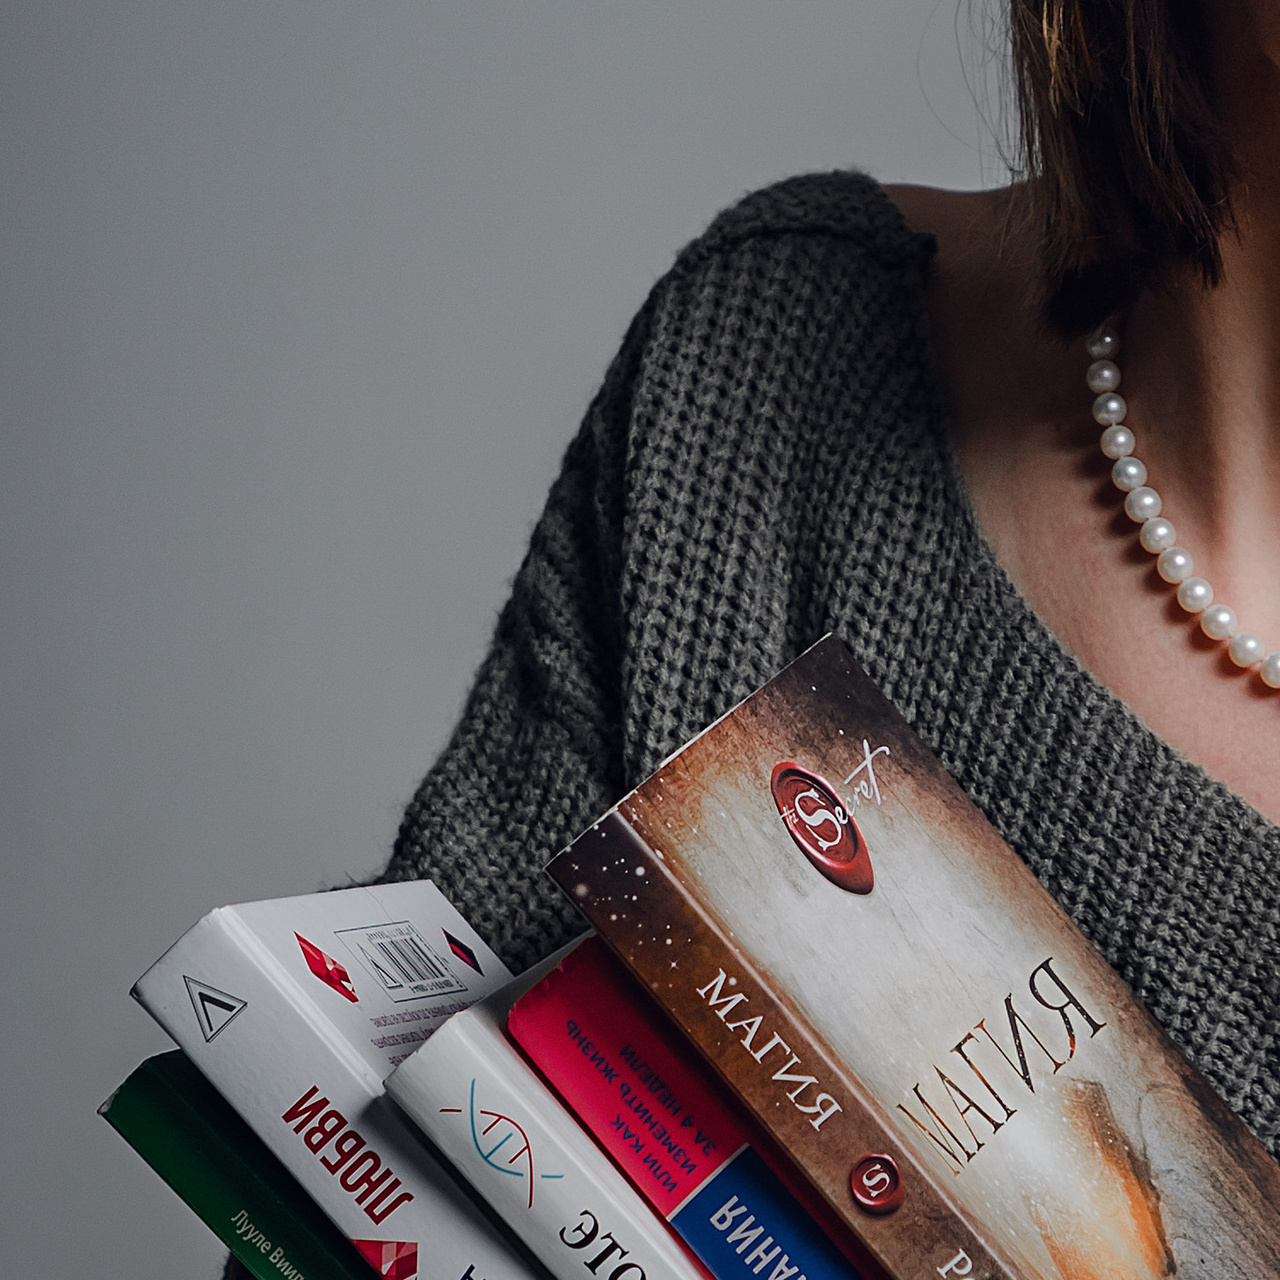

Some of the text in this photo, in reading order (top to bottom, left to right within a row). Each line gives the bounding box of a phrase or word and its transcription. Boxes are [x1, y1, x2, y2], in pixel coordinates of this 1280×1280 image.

[566, 1020, 697, 1175] ИЗМЕНИТЬ ЖИЗНЬ
[619, 1044, 682, 1116] НЕДЕЛИ
[697, 967, 843, 1131] МАГИЯ
[896, 957, 1107, 1176] МАГИЯ
[281, 1085, 415, 1226] ЛЮБВИ
[611, 1115, 677, 1193] ИЛИ КАК
[694, 1130, 717, 1157] ЗА
[231, 1209, 272, 1255] Лууле
